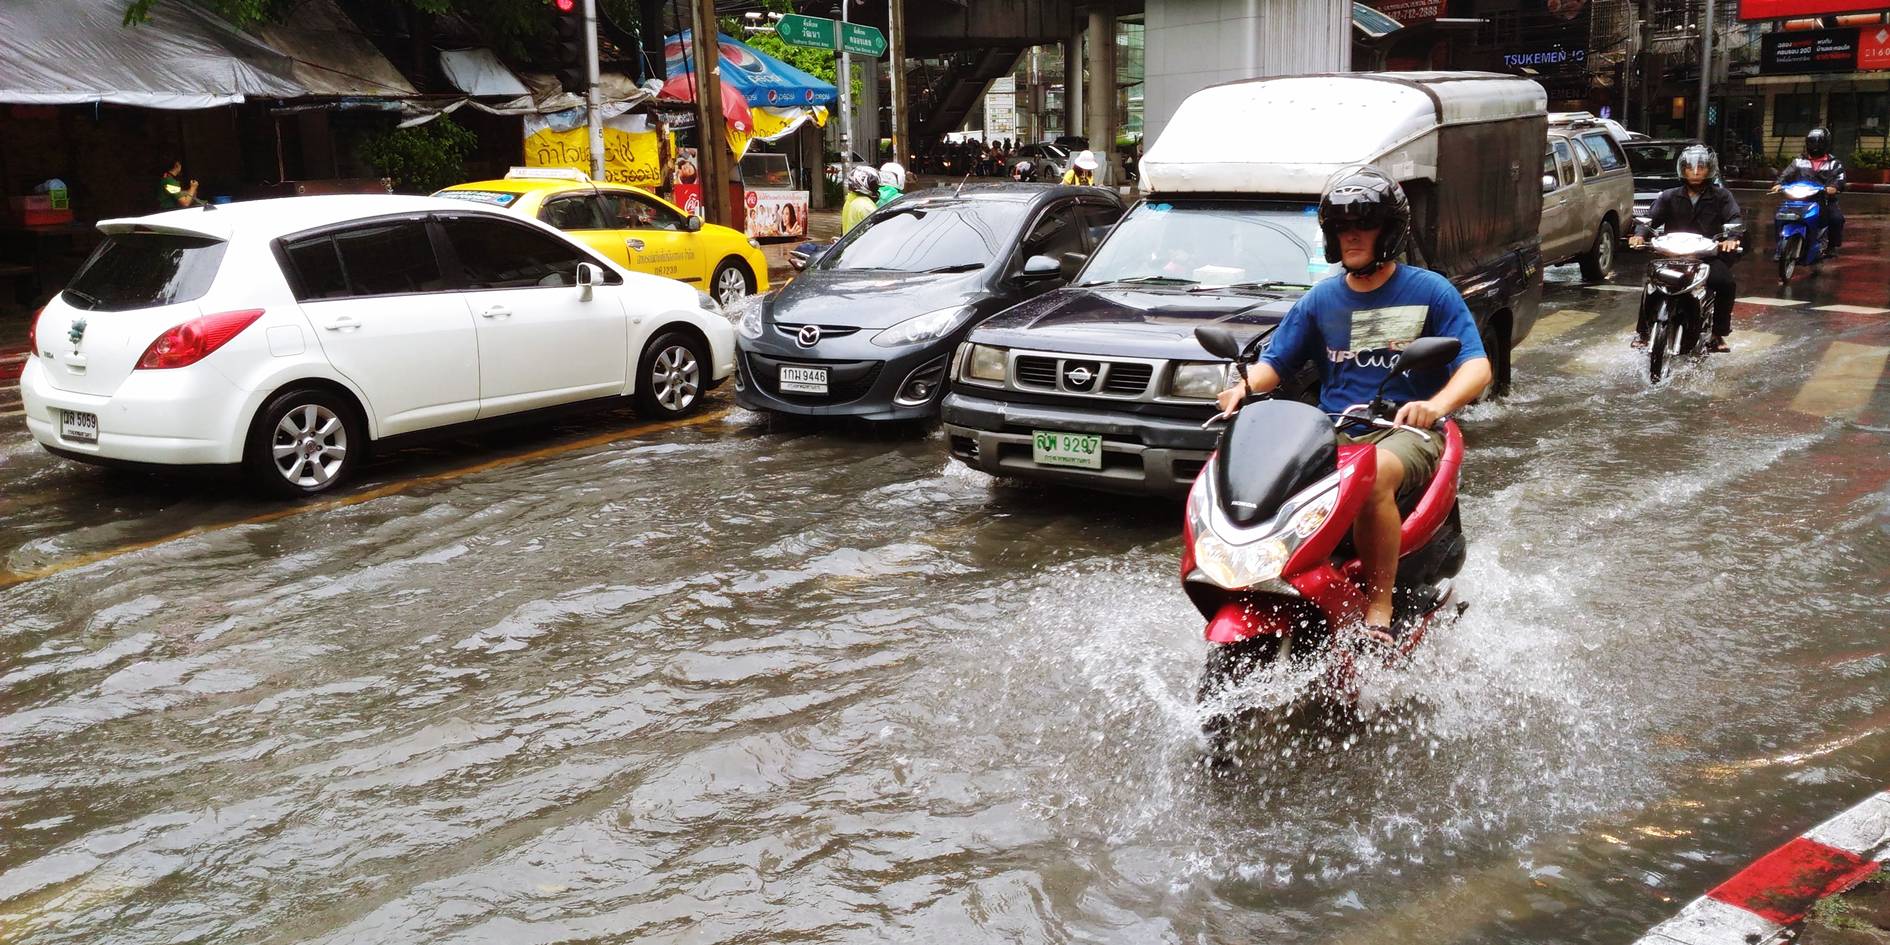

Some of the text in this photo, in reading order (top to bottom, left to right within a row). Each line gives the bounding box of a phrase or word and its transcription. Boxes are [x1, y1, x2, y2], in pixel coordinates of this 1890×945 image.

[1504, 50, 1567, 65] TSUKEMEN
[778, 93, 795, 101] pepsi
[815, 92, 831, 100] pepsi
[784, 368, 826, 382] 1กม 9446
[77, 412, 96, 428] 5059
[1064, 436, 1098, 454] 9297
